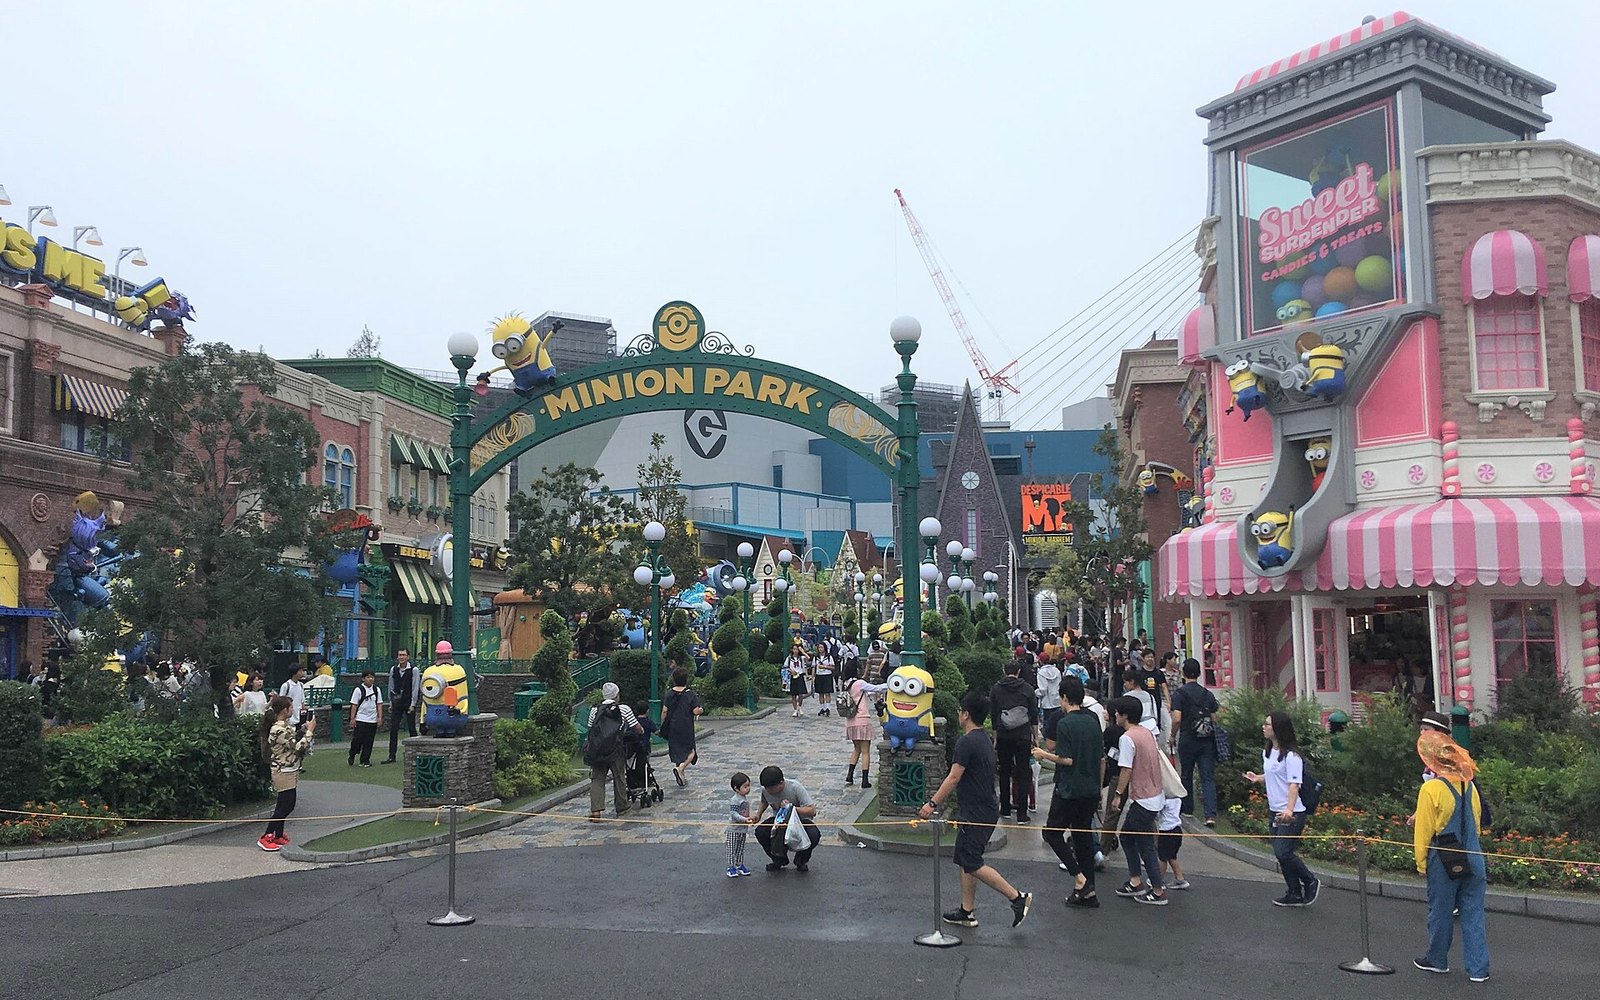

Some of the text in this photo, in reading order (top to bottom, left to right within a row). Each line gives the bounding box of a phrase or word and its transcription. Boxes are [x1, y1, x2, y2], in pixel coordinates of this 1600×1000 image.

[1259, 163, 1377, 247] Sweet
[1260, 197, 1378, 262] SURRENDER
[43, 240, 105, 298] ME
[1261, 251, 1316, 281] CANDIES
[1331, 222, 1383, 250] TREATS
[545, 367, 818, 421] MINION PARK
[1021, 483, 1071, 494] DESPICABLE
